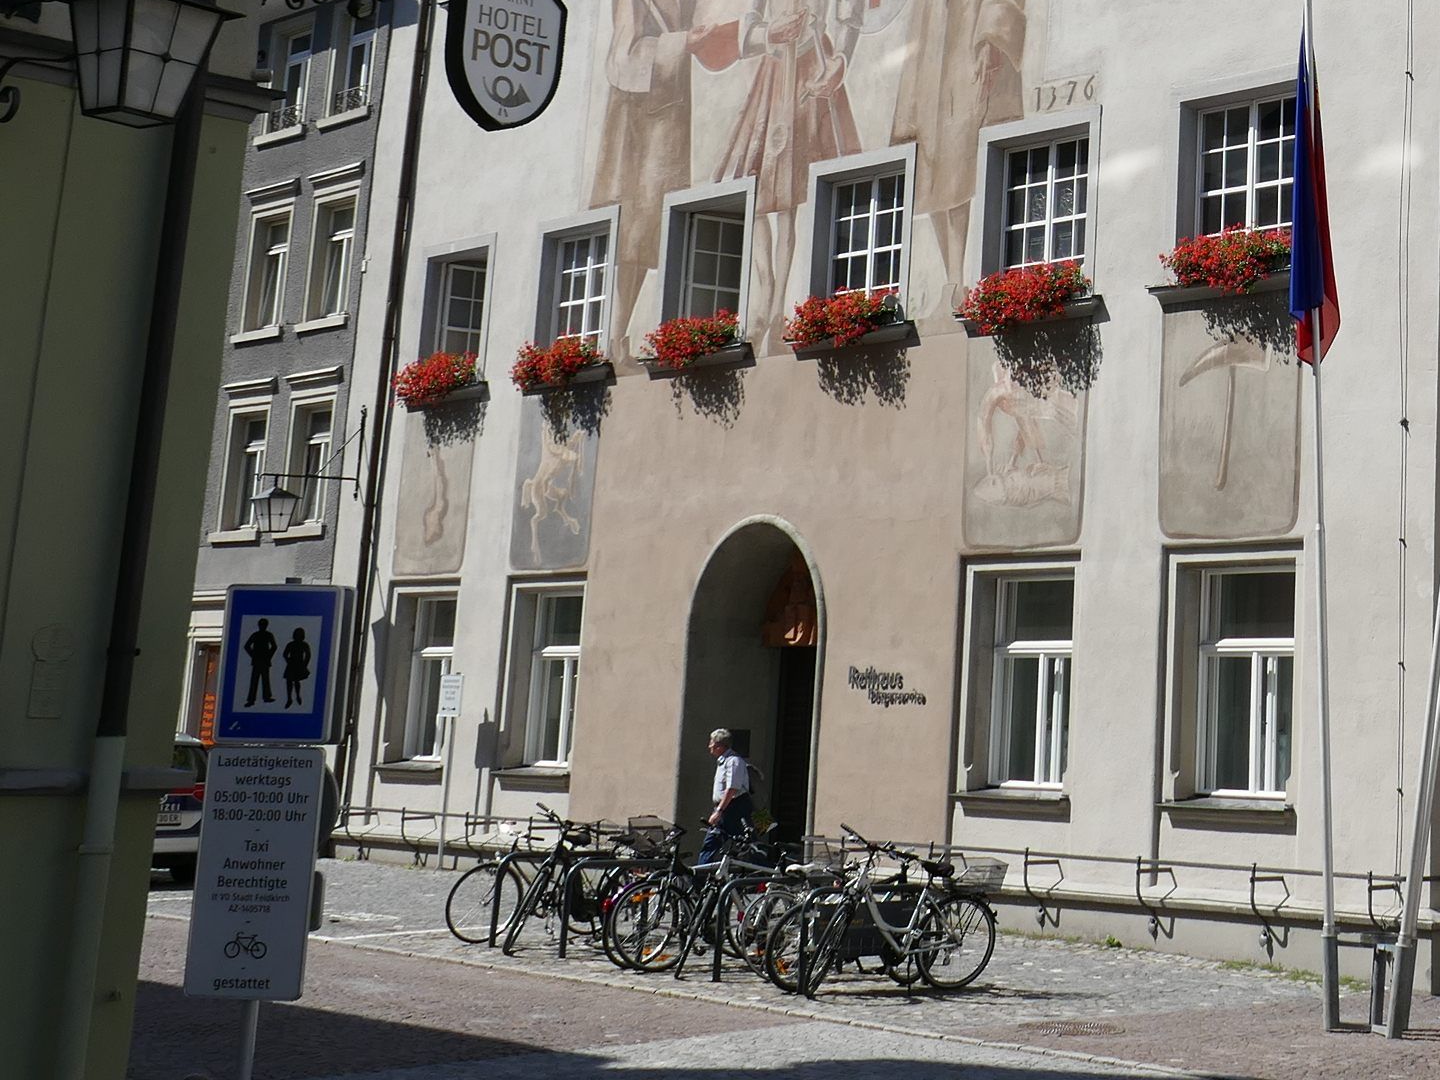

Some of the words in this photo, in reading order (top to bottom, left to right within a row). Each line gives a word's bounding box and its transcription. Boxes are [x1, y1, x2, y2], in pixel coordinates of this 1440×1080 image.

[478, 3, 548, 40] HOTEL
[470, 27, 551, 76] POST
[1033, 74, 1096, 113] 1376
[217, 755, 313, 770] Ladetätigkeiten
[235, 774, 292, 787] werktags
[214, 791, 283, 804] 05:00-10:00
[287, 793, 309, 804] Uhr
[212, 808, 281, 821] 18:00-20:00
[285, 810, 307, 822] Uhr
[243, 840, 269, 853] Taxi
[223, 858, 286, 871] Anwohner
[217, 875, 288, 890] Berechtigte
[232, 893, 253, 902] Stadt
[255, 893, 290, 902] Feldkirch
[213, 976, 270, 991] gestattet
